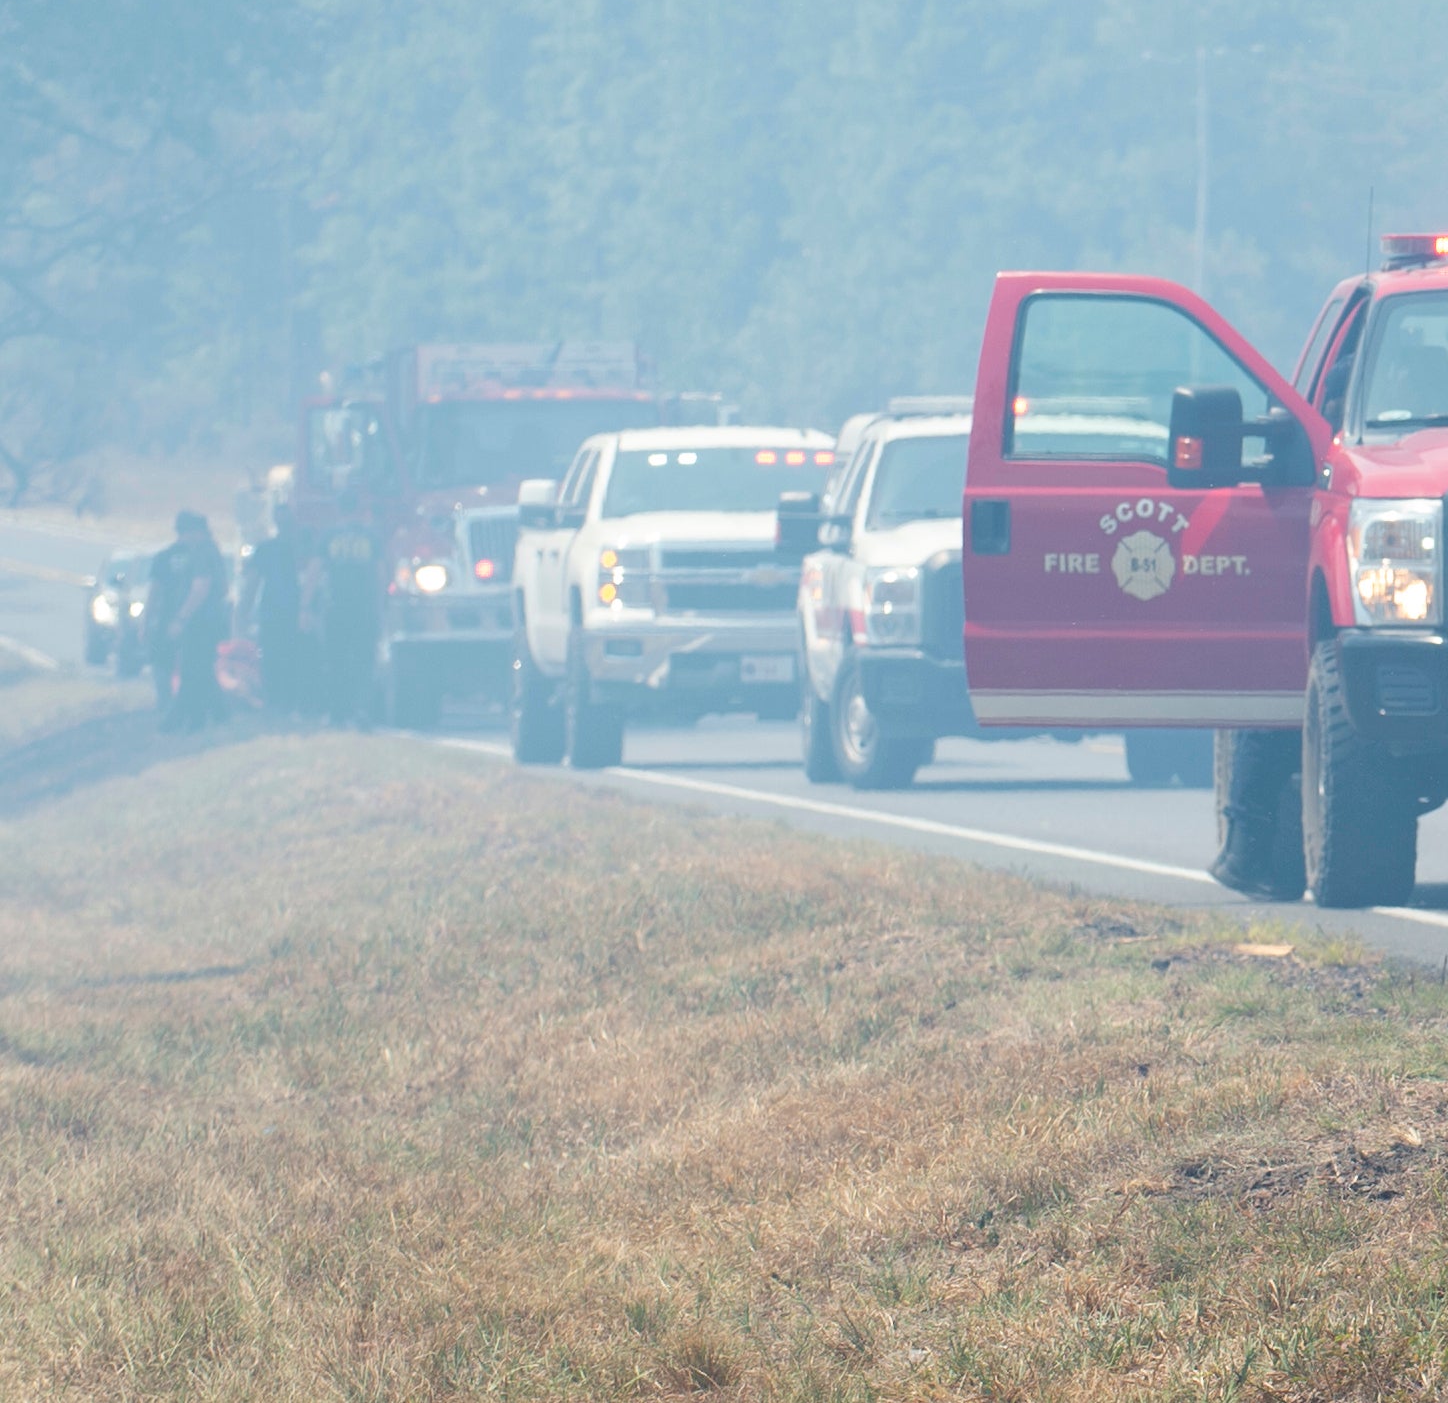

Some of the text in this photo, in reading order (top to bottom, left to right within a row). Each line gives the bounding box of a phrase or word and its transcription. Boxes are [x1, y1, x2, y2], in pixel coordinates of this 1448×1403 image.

[1099, 498, 1190, 535] SCOTT
[1044, 553, 1250, 575] FIRE DEPT.
